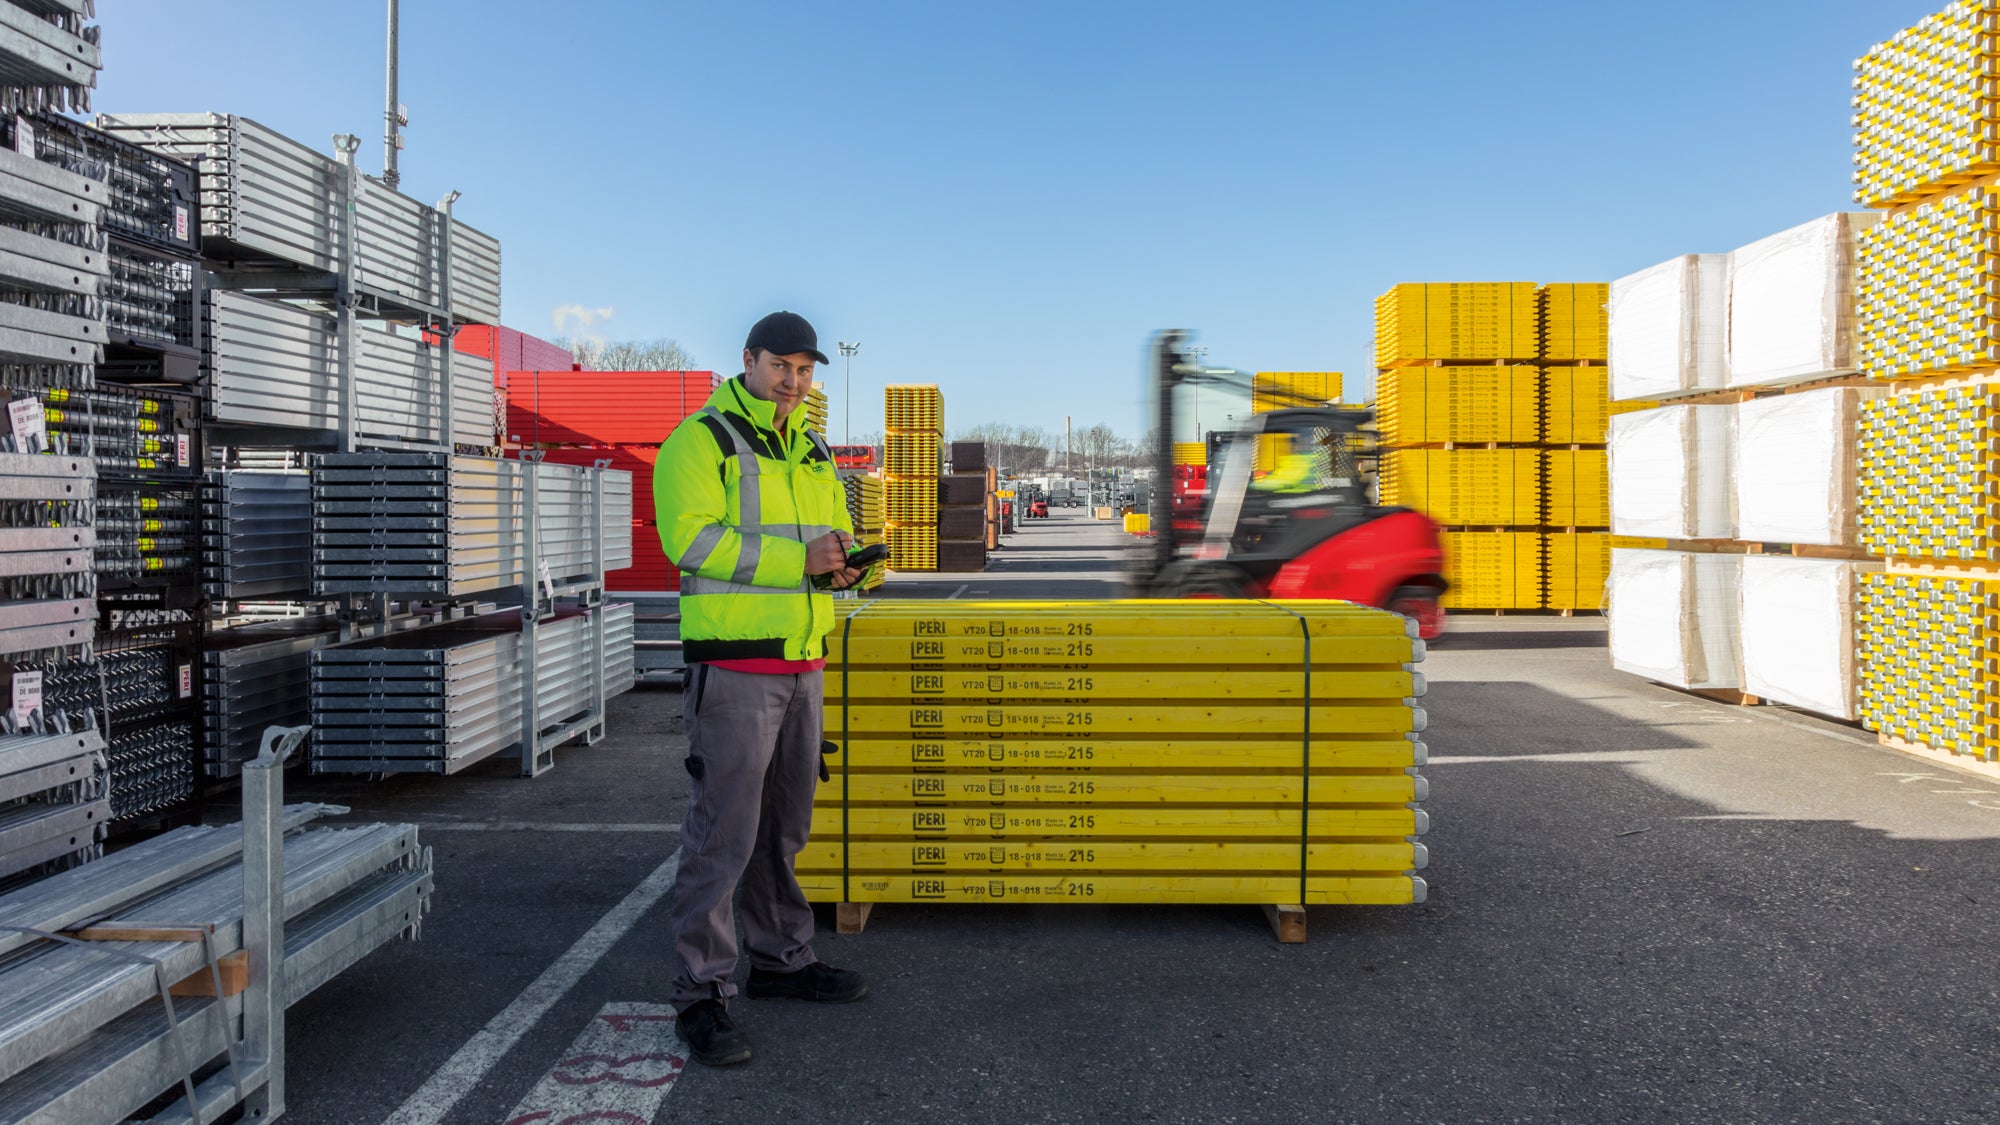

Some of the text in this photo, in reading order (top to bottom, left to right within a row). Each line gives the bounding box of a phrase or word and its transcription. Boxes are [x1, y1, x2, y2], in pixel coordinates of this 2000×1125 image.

[176, 212, 186, 234] PERI
[178, 439, 188, 463] PERI
[918, 621, 945, 633] PERI
[963, 626, 985, 634] VT20
[1008, 626, 1040, 634] 18-018
[1067, 624, 1093, 635] 215
[916, 641, 943, 654] PERI
[961, 647, 984, 655] VT20
[1007, 647, 1039, 655] 18-018
[1067, 643, 1093, 656] 215
[183, 671, 191, 691] PERI
[916, 676, 943, 688] PERI
[961, 681, 984, 689] VT20
[1007, 681, 1040, 689] 18-018
[1068, 678, 1093, 690] 215
[915, 710, 942, 722] PERI
[961, 715, 983, 723] VT20
[1006, 715, 1039, 723] 18-018
[1066, 713, 1092, 725] 215
[917, 744, 943, 757] PERI
[962, 750, 985, 758] VT20
[1008, 750, 1040, 758] 18-018
[1068, 747, 1093, 759] 215
[917, 779, 944, 791] PERI
[963, 784, 985, 792] VT20
[1009, 784, 1040, 792] 18-018
[1069, 782, 1094, 794] 215
[918, 813, 945, 825] PERI
[963, 818, 986, 826] VT20
[1009, 818, 1041, 826] 18-018
[1069, 816, 1094, 828] 215
[918, 847, 945, 859] PERI
[963, 852, 986, 860] VT20
[1009, 852, 1041, 860] 18-018
[1069, 850, 1094, 862] 215
[917, 881, 945, 893] PERI
[962, 886, 985, 894] VT20
[1008, 886, 1040, 894] 18-018
[1068, 883, 1094, 896] 215
